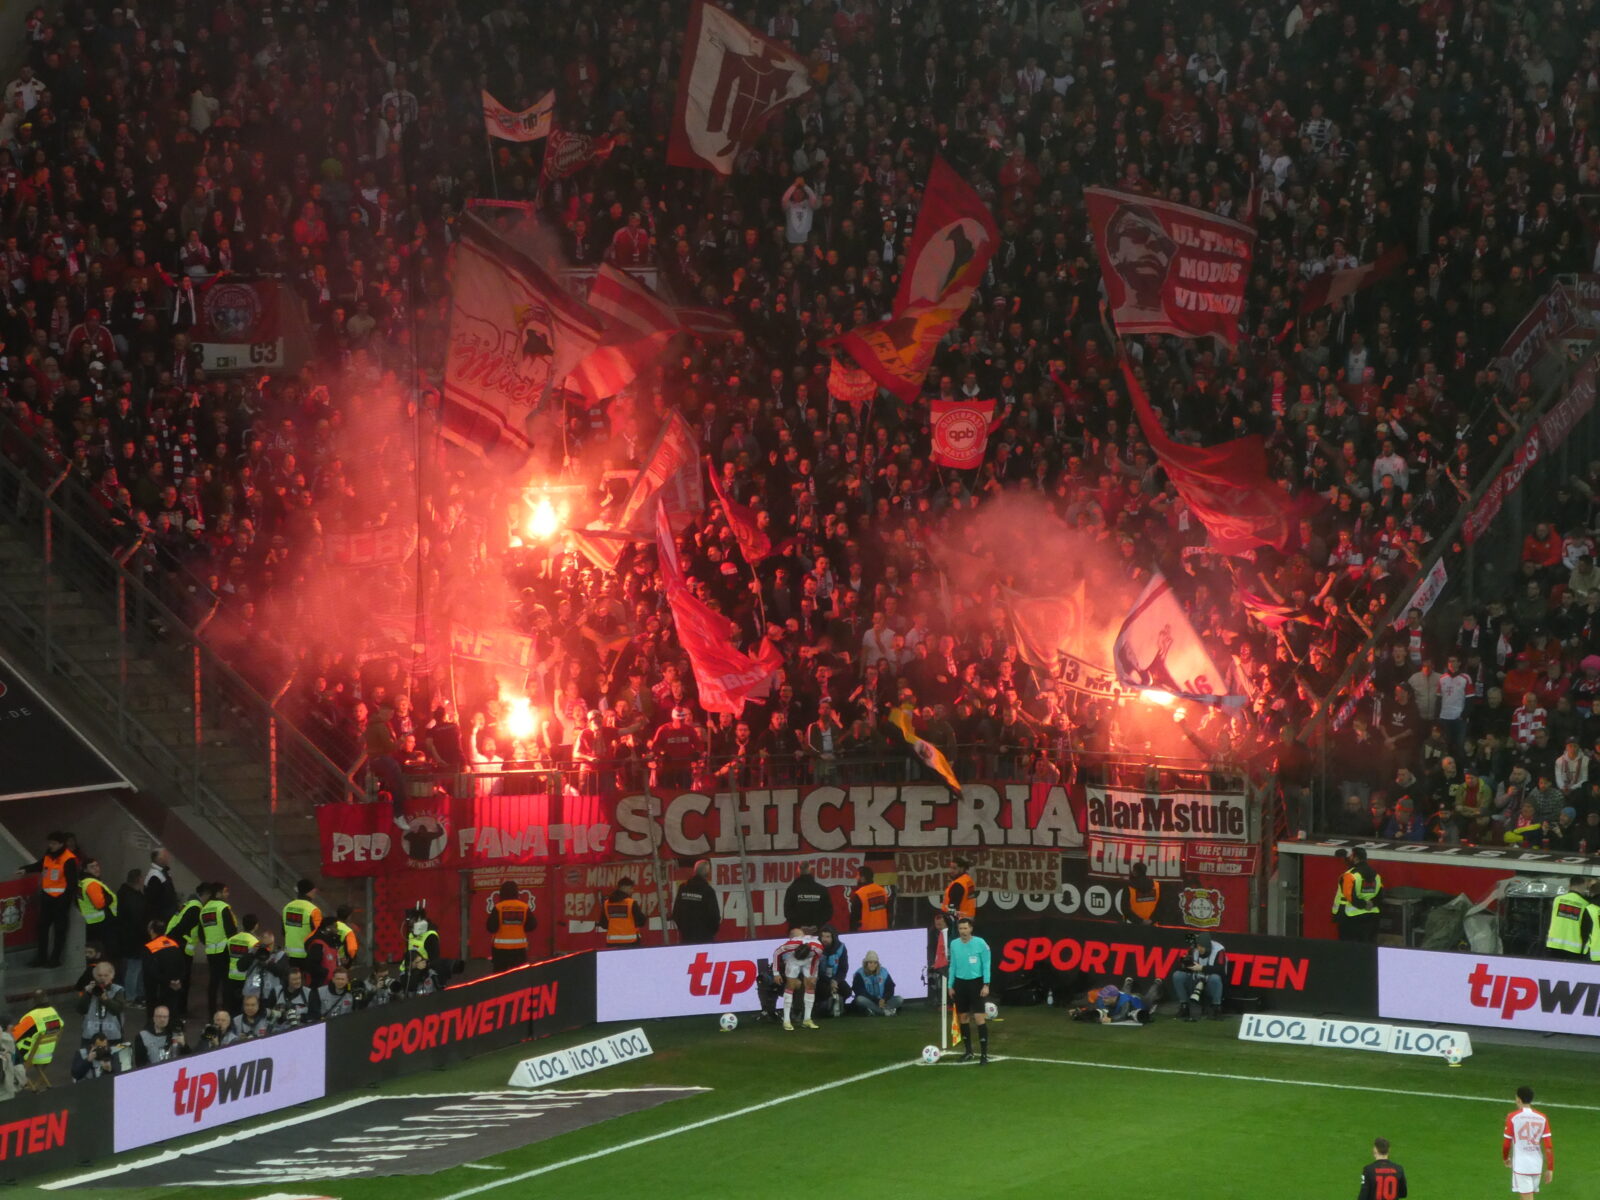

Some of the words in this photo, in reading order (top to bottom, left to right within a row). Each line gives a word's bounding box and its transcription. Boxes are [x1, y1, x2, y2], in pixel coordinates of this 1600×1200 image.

[1171, 222, 1250, 259] ULTRAS
[1179, 256, 1242, 283] MODUS
[250, 343, 278, 364] G3
[615, 783, 1085, 857] SCHICKERIA
[1089, 794, 1244, 835] alarMstufe
[332, 832, 391, 862] RED
[458, 823, 611, 858] FANATIC
[716, 862, 756, 886] RED
[897, 873, 952, 895] IMME
[976, 868, 1009, 890] BEI
[1015, 872, 1057, 891] UNS
[998, 937, 1309, 991] SPORTWTEN
[1467, 963, 1600, 1020] tipwi
[368, 981, 558, 1063] SPORTWETTEN
[1246, 1016, 1306, 1041] iLOQ
[1319, 1021, 1381, 1047] iLOQ
[526, 1056, 568, 1083] iLOQ
[569, 1046, 608, 1070] iLOQ
[610, 1035, 648, 1060] iLOQ
[172, 1057, 274, 1123] tipwin
[1375, 1176, 1398, 1200] 10
